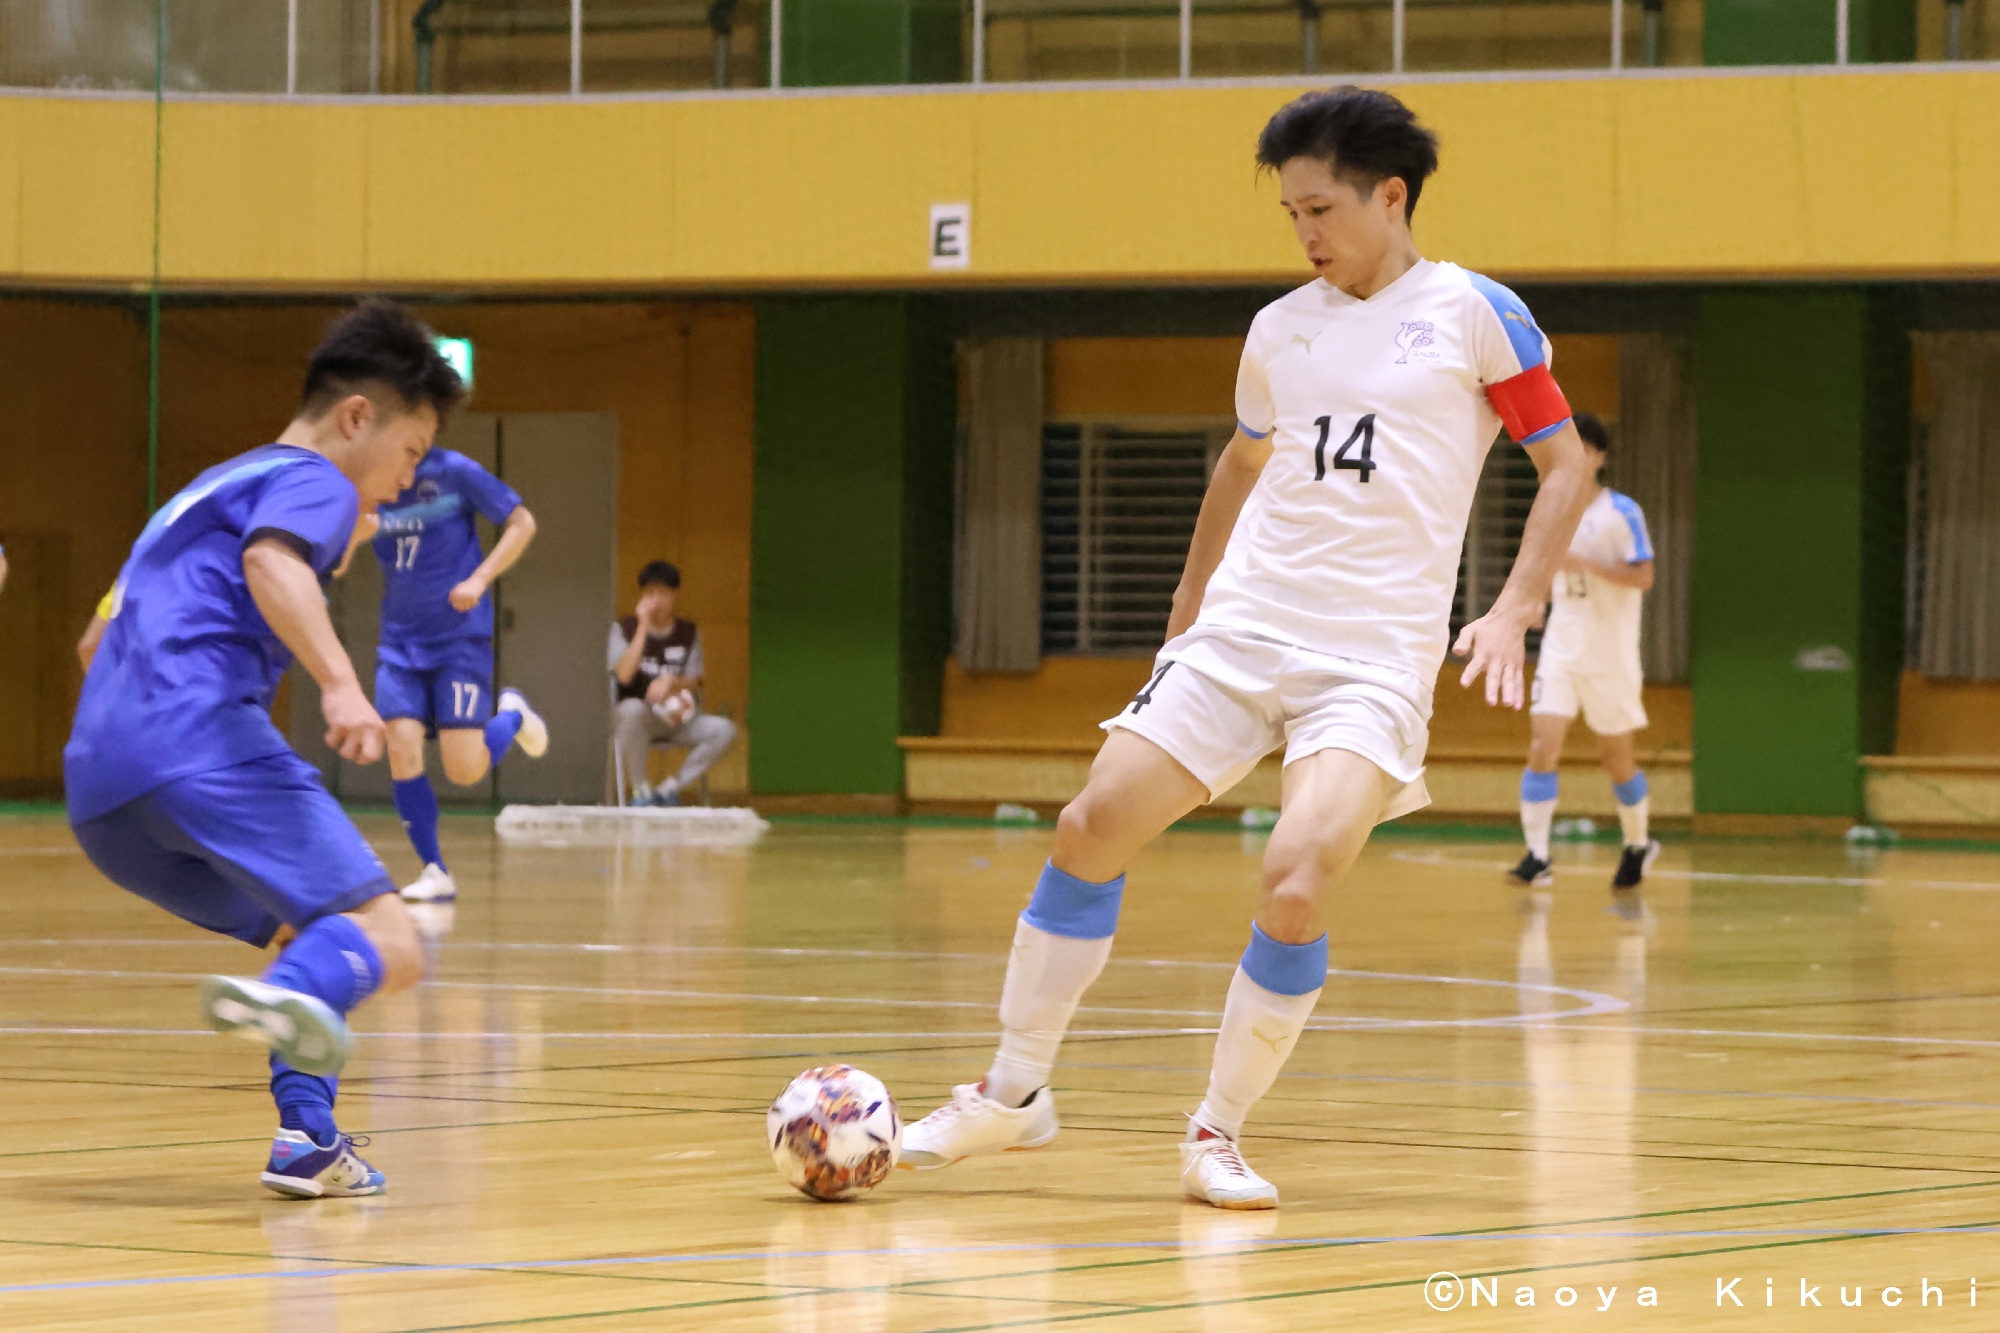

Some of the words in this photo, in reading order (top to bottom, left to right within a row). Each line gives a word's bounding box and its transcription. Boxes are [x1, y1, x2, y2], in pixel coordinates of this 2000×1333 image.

[935, 216, 961, 256] E
[1313, 413, 1377, 483] 14
[395, 535, 420, 571] 17
[451, 681, 479, 719] 17
